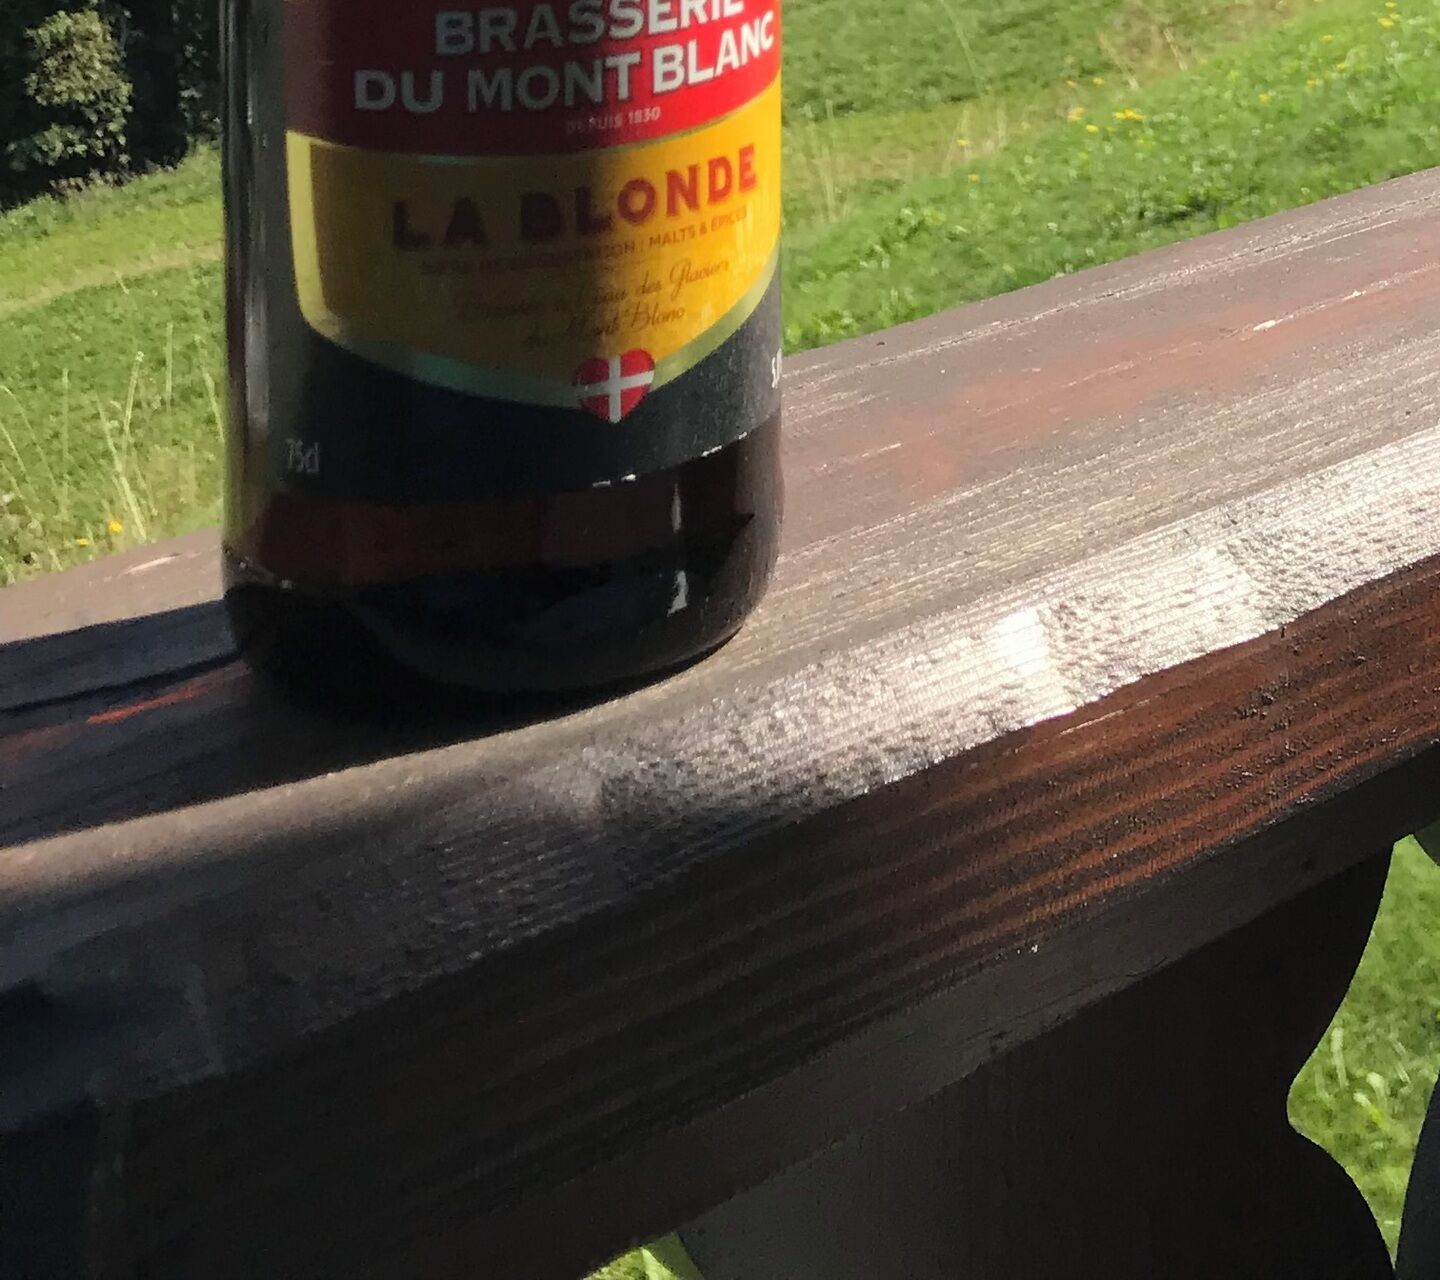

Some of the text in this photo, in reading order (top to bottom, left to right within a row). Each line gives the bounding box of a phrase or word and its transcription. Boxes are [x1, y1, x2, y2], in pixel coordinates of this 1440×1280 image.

[353, 11, 776, 113] DU MONT BLANC
[391, 143, 758, 252] LA BLONDE
[649, 226, 696, 248] MALTS
